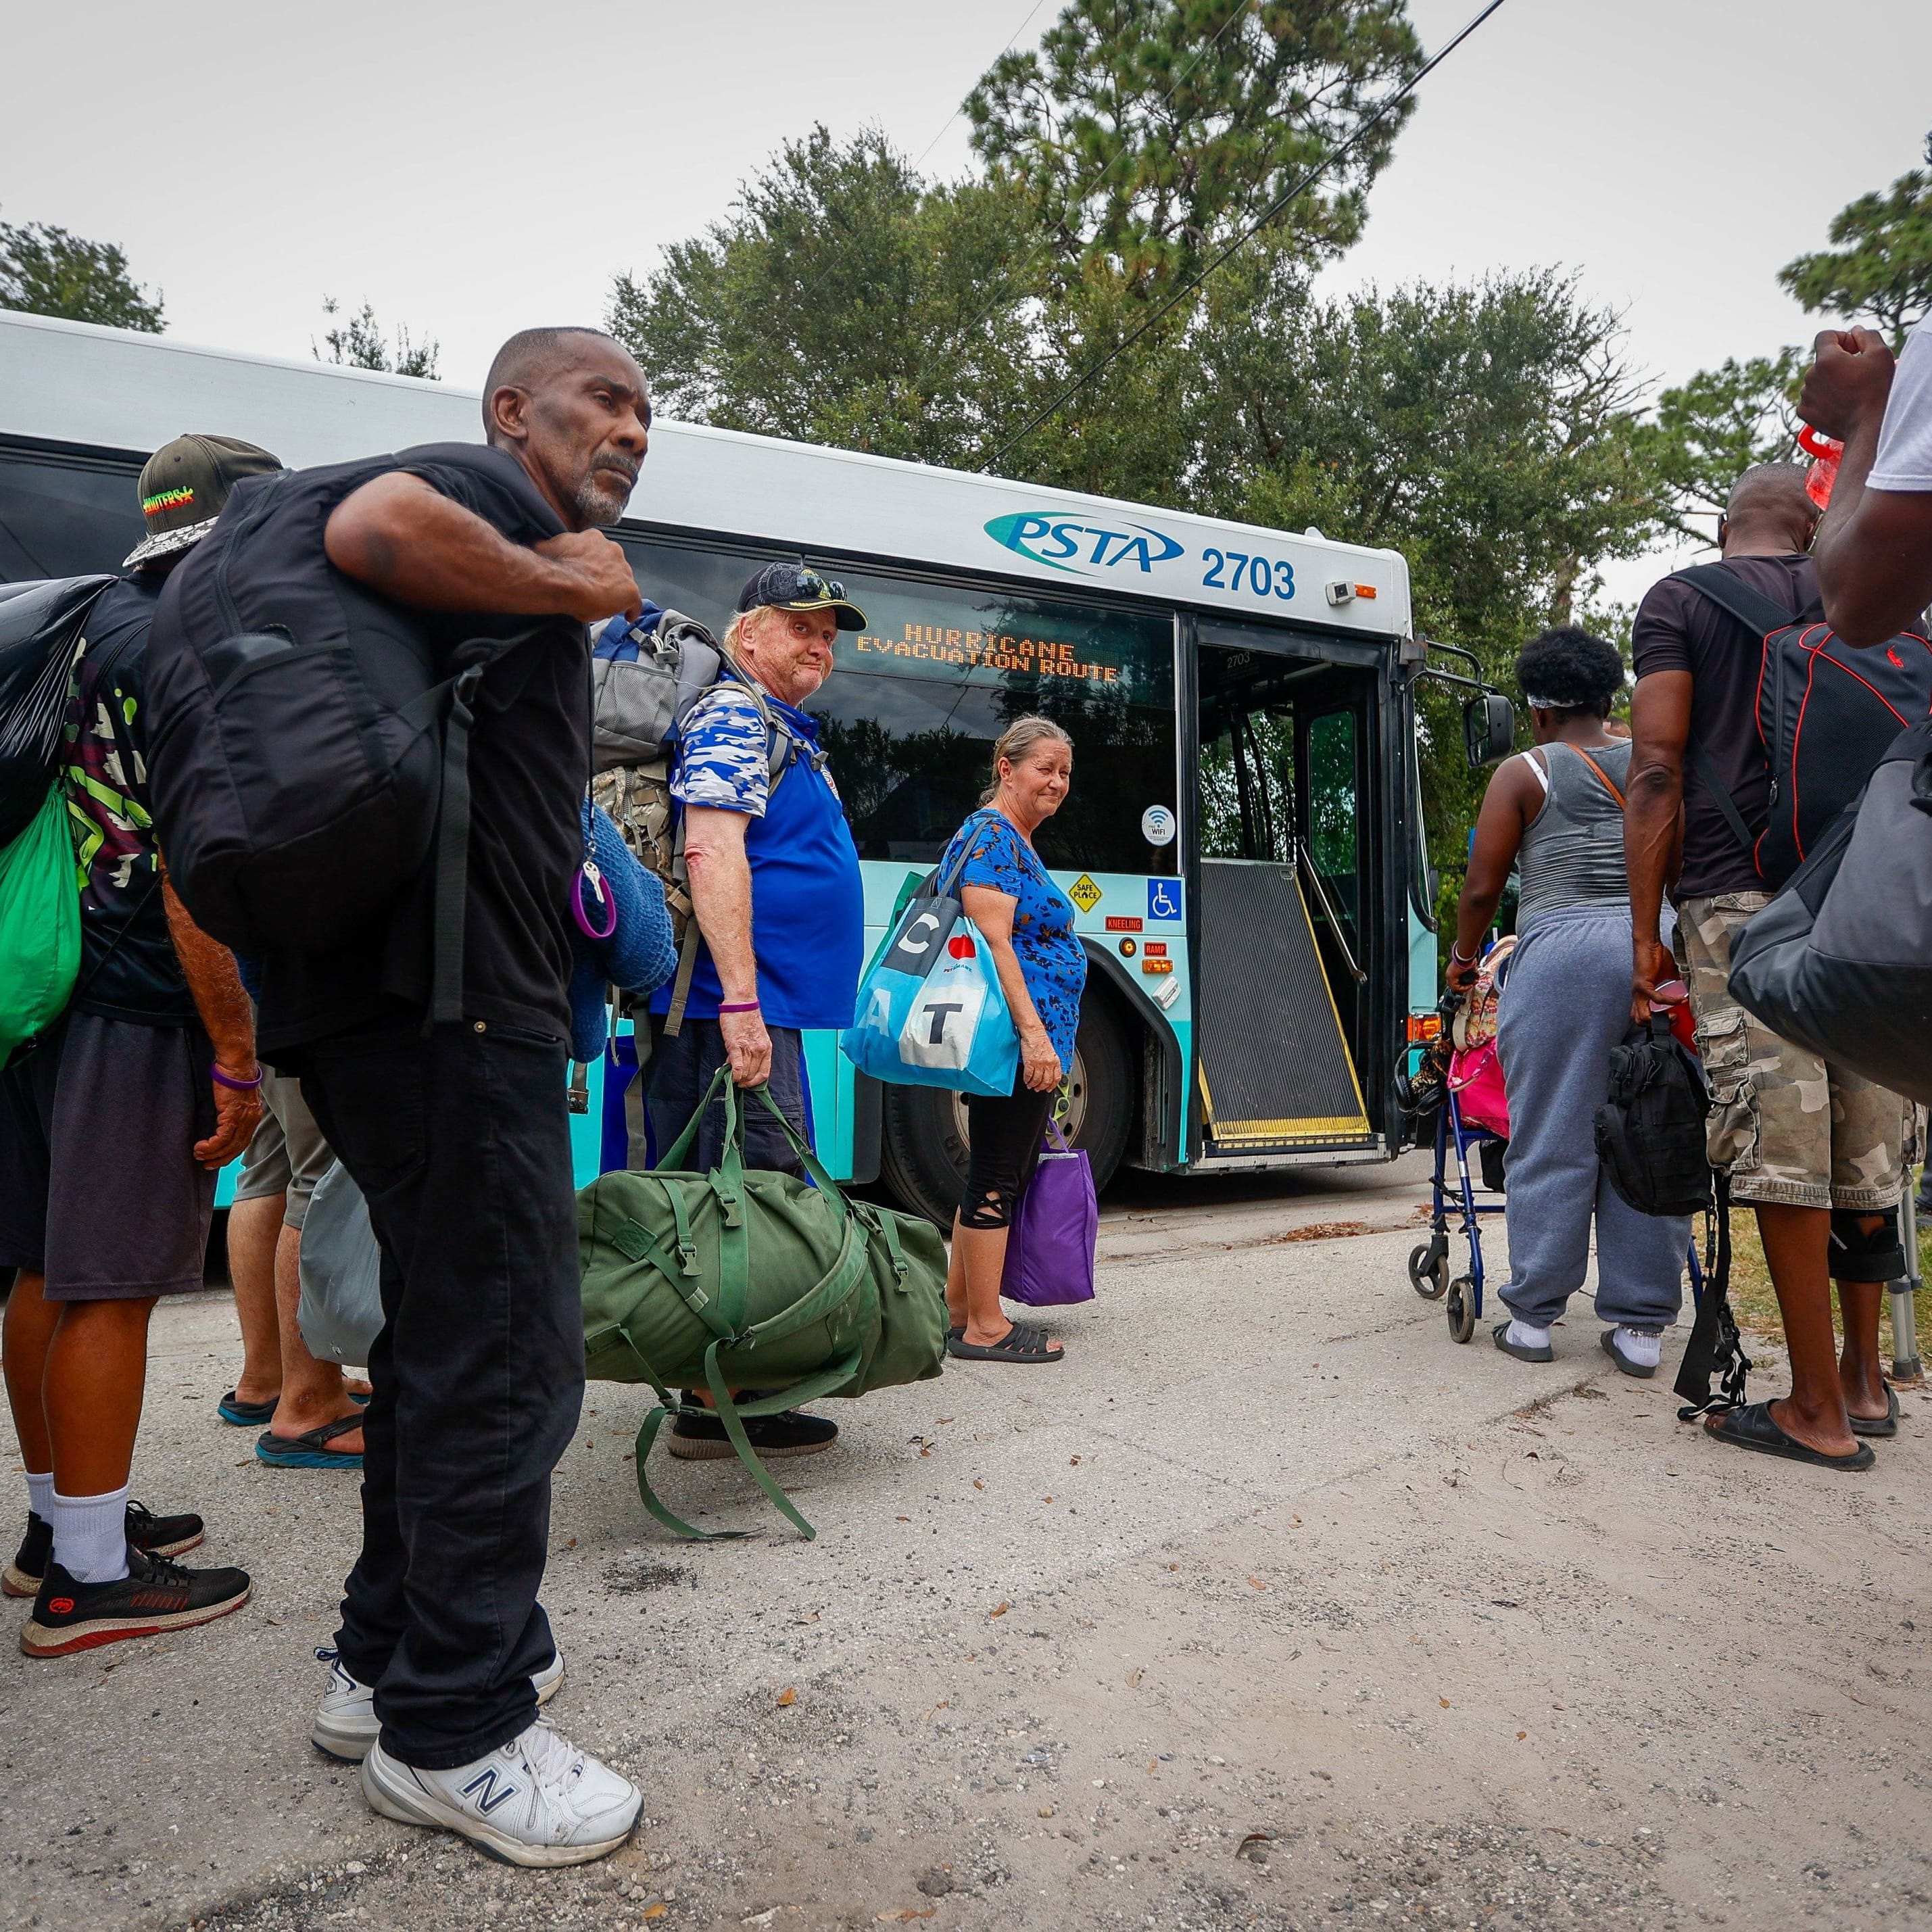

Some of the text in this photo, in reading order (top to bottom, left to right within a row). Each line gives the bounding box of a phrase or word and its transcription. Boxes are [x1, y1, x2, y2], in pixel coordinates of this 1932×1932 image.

[1005, 516, 1296, 600] PSTA 2703
[856, 635, 1117, 682] EVACUATION ROUTE
[904, 623, 1075, 662] HURRICANE
[1227, 651, 1251, 669] 2703
[898, 913, 940, 953] C
[1108, 919, 1140, 929] KNEELING
[1146, 945, 1165, 954] RAMP
[857, 988, 891, 1037] A
[923, 1003, 963, 1044] T
[460, 1767, 518, 1815] N
